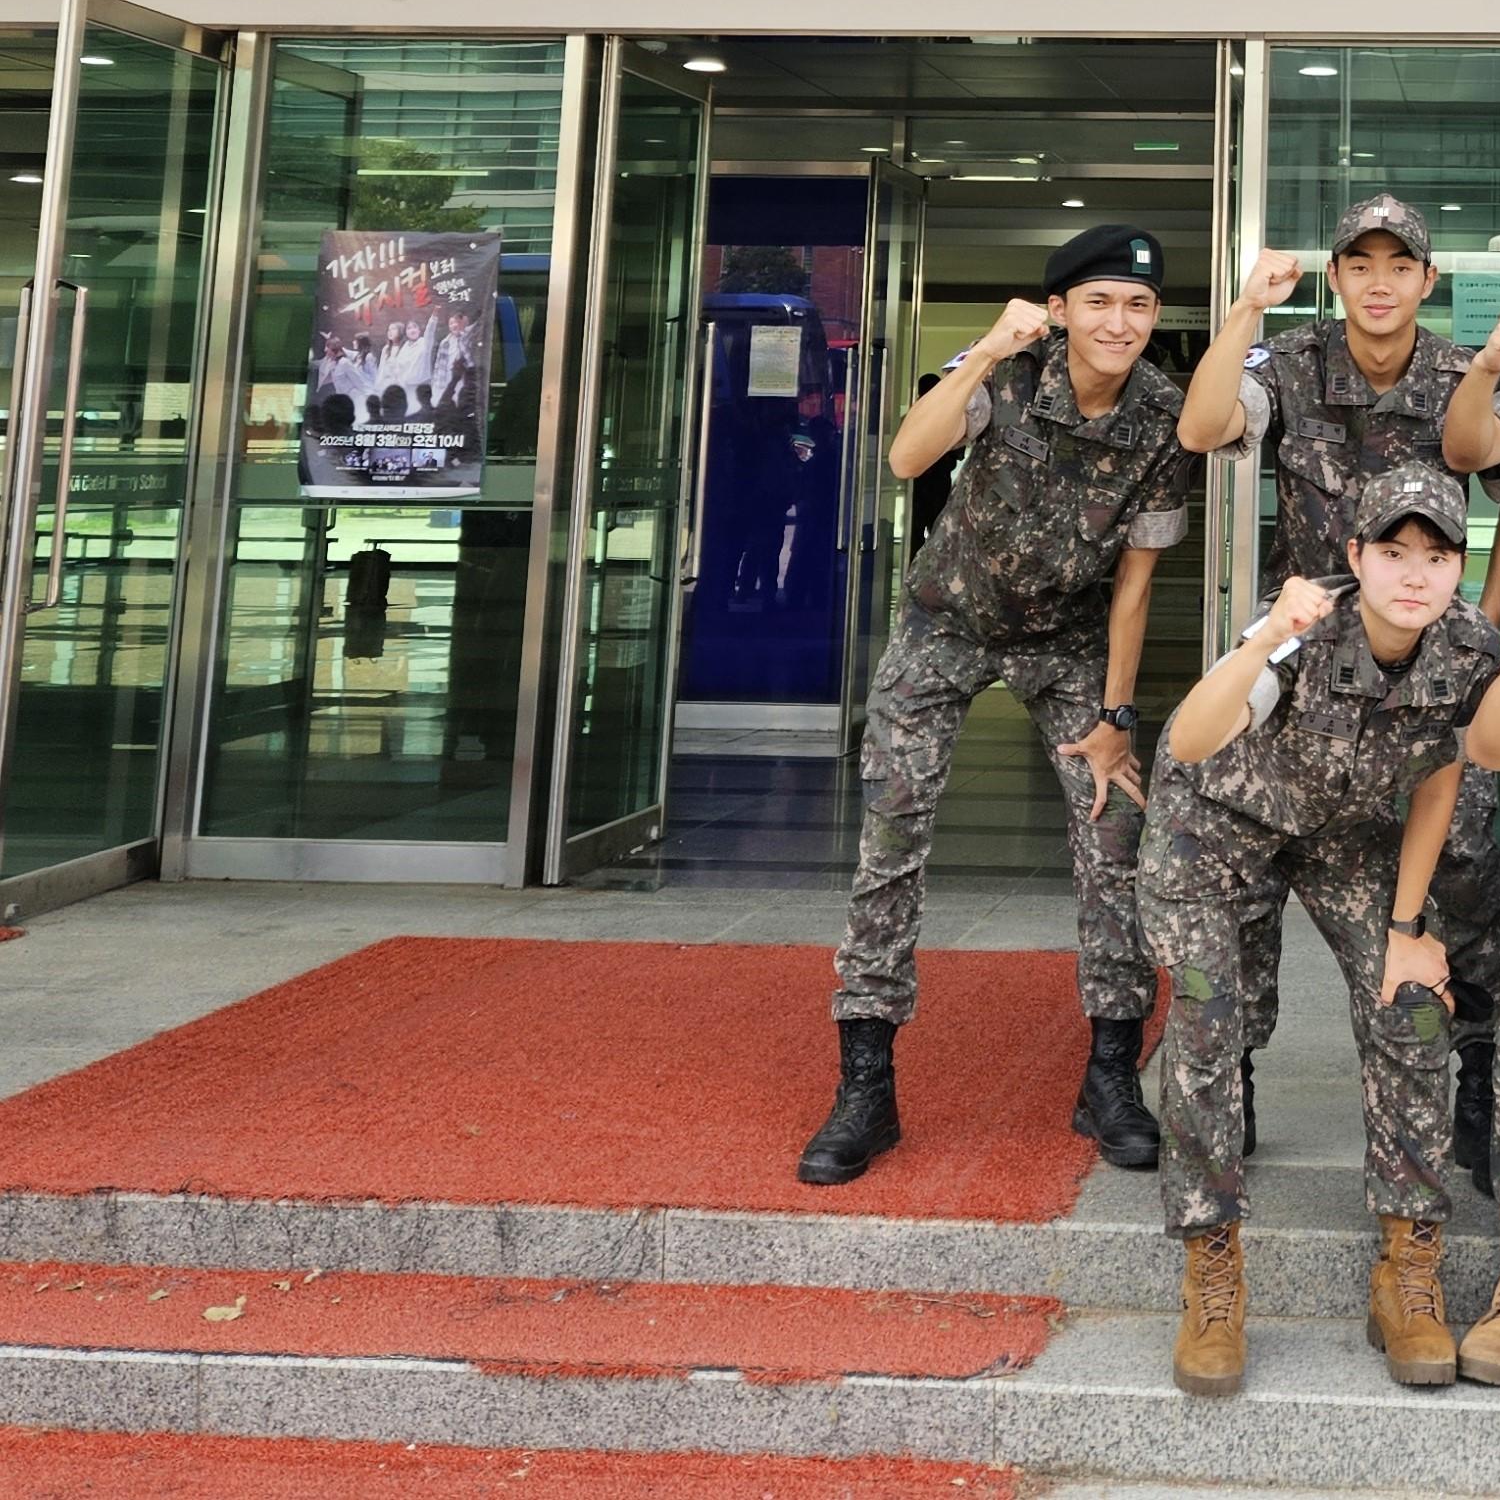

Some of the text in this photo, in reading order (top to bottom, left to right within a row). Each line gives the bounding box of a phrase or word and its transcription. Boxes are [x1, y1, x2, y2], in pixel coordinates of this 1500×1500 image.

[326, 236, 405, 279] 가자!!!
[339, 257, 455, 325] 뮤지컬 보러
[320, 435, 354, 447] 2025년
[355, 434, 376, 447] 8월
[412, 434, 437, 448] 오전
[438, 434, 464, 448] 10시
